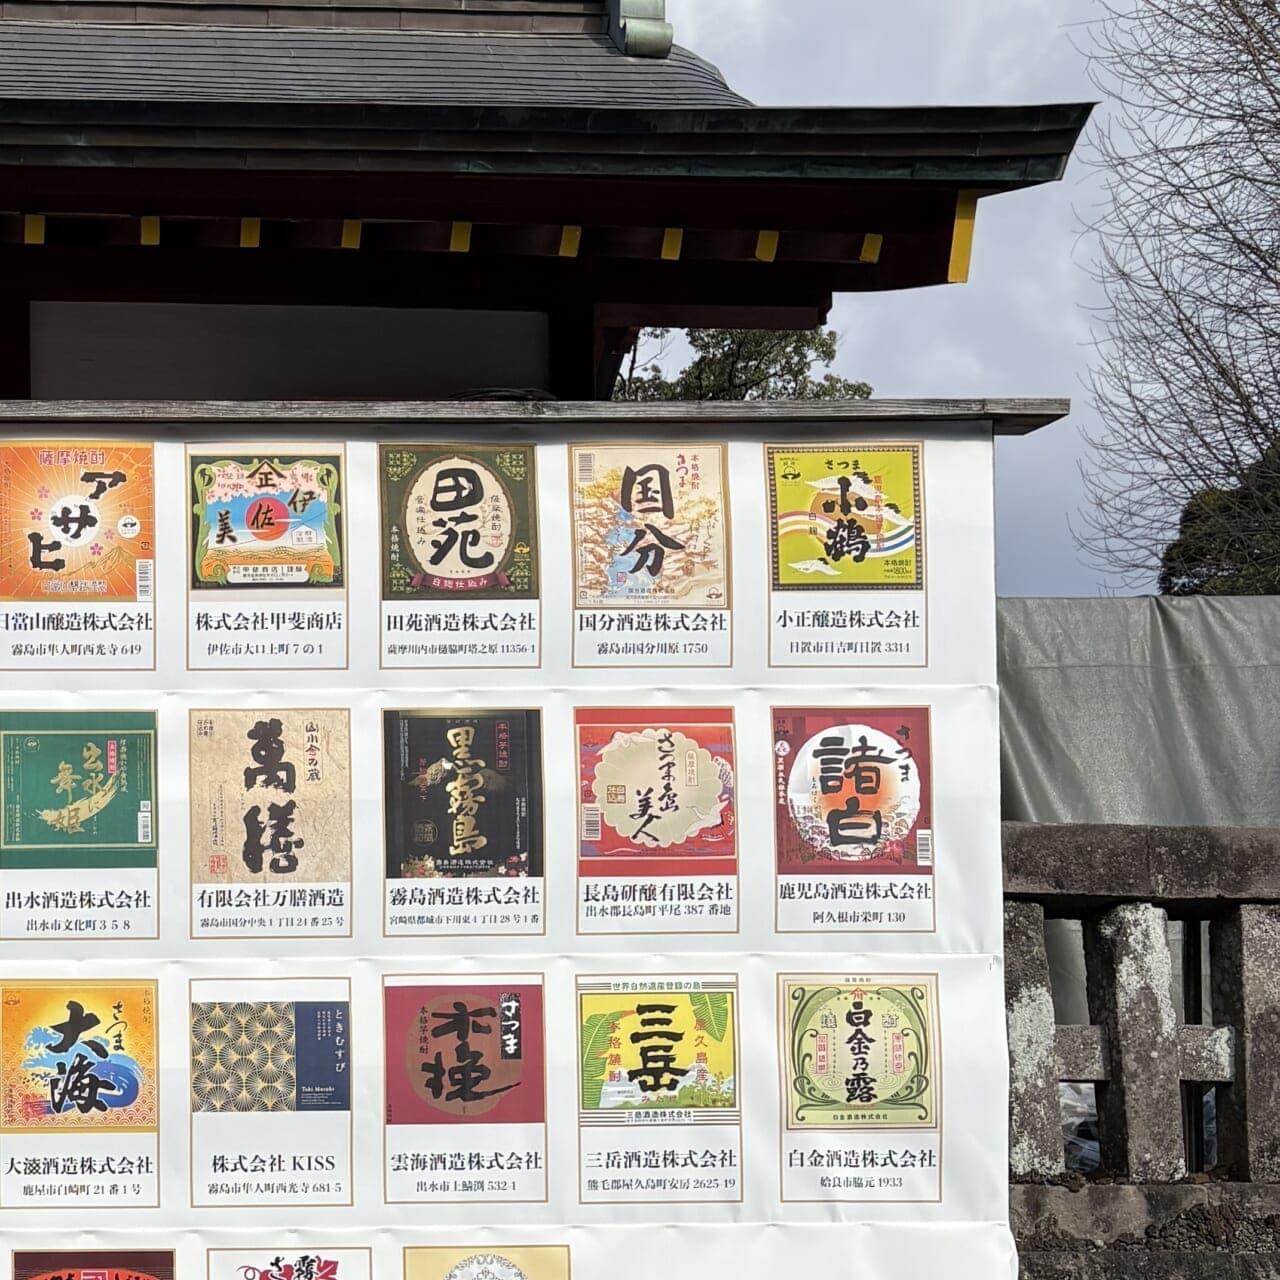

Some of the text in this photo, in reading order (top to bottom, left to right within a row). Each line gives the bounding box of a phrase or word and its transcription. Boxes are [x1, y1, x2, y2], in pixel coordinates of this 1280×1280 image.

[39, 449, 105, 466] 薩摩焼酎
[825, 459, 861, 471] さつま
[430, 468, 493, 569] 田苑
[620, 464, 684, 576] 国分
[822, 476, 871, 563] 小鶴
[195, 612, 342, 631] 株式会社甲斐商店
[387, 612, 536, 631] 田苑酒造株式会社
[579, 613, 727, 631] 国分酒造株式会社
[776, 610, 919, 628] 小正醸造株式会社
[241, 718, 304, 874] 萬膳
[445, 726, 489, 855] 黒霧島
[812, 736, 896, 846] 諸白
[6, 890, 151, 909] 出水酒造株式会社
[197, 888, 344, 908] 有限会社万膳酒造
[390, 886, 539, 906] 霧島酒造株式会社
[584, 882, 733, 902] 長島研醸有限会社
[779, 882, 933, 899] 鹿児島酒造株式会社
[612, 982, 701, 991] 世界自然遺産登録の島
[501, 1000, 520, 1055] さつま
[335, 1009, 347, 1072] ときむすび
[627, 1004, 689, 1094] 三岳
[46, 1001, 117, 1114] 大海
[391, 1152, 542, 1171] 雲海酒造株式会社
[586, 1149, 736, 1168] 三岳酒造株式会社
[789, 1149, 936, 1168] 白金酒造株式会社
